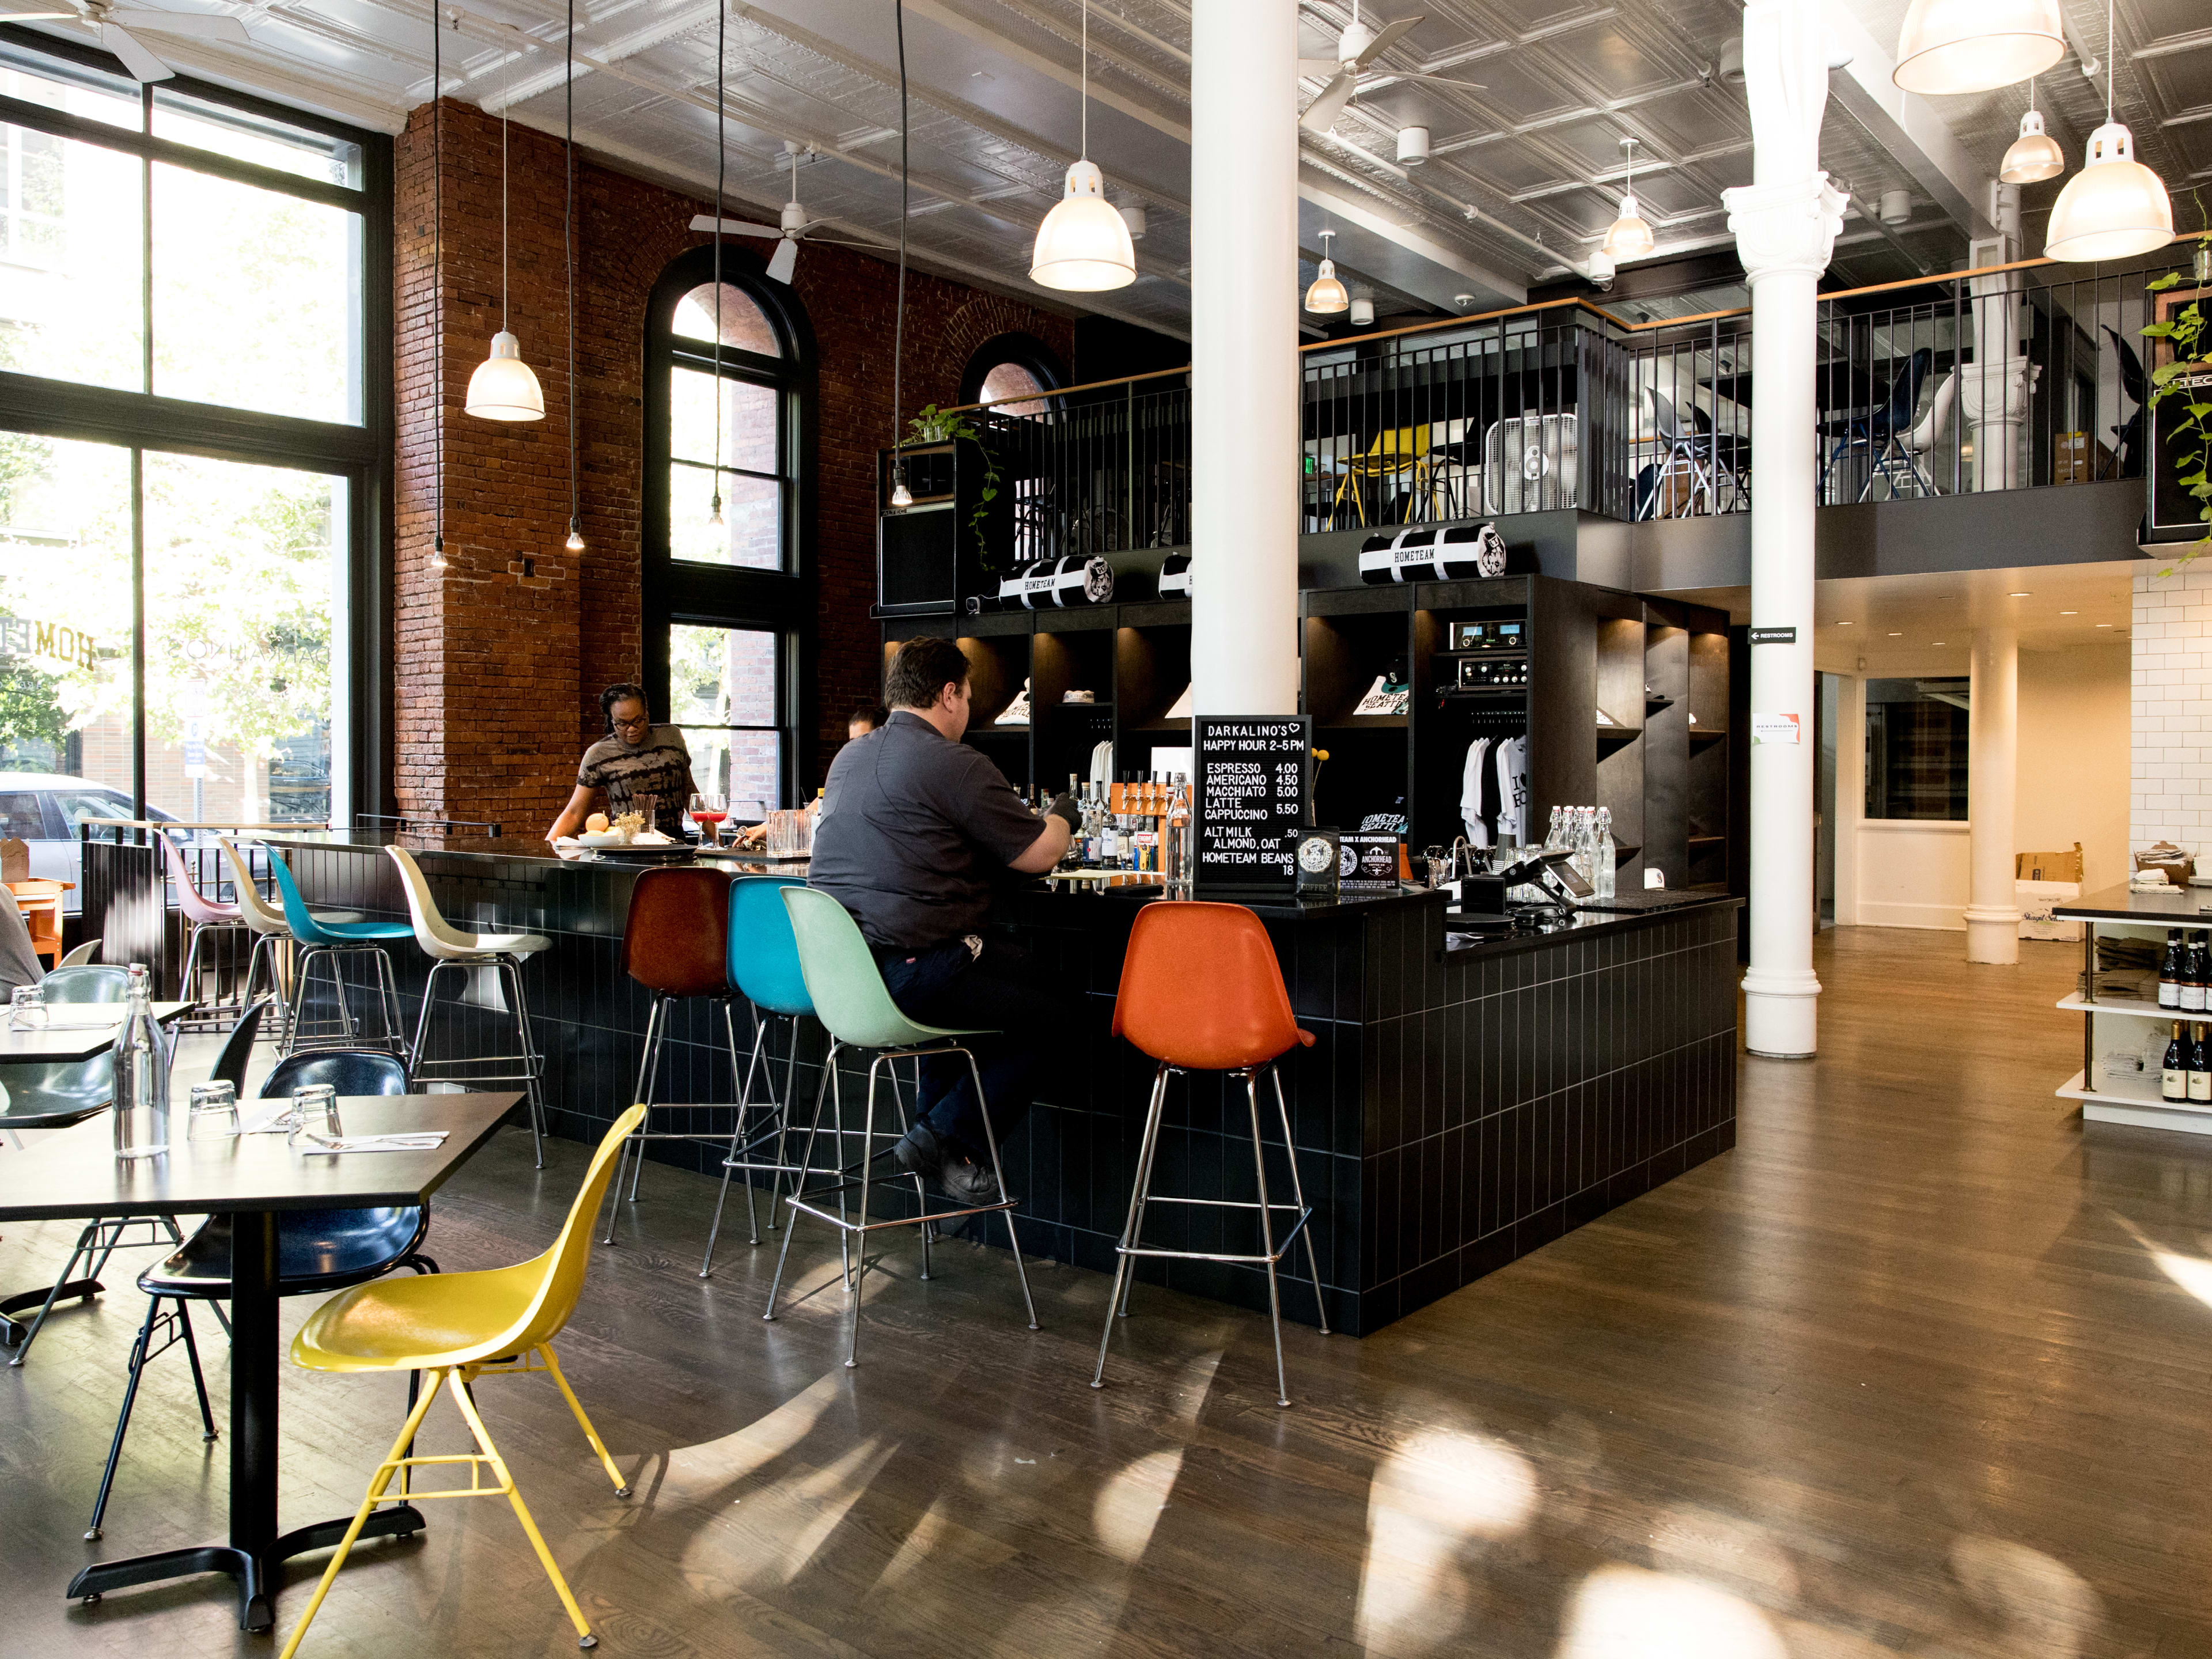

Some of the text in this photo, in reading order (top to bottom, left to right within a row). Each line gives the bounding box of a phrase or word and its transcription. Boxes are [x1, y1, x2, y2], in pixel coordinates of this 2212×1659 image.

[1395, 548, 1435, 563] HOMETEAM
[1025, 578, 1056, 590] HOMETEAM
[1209, 725, 1287, 736] DARKALINO'S
[1204, 740, 1236, 750] HAPPY
[1239, 740, 1266, 750] HOUR
[1290, 740, 1304, 750] PM
[1207, 763, 1298, 774] ESPRESSO 4.00
[1207, 775, 1297, 785] AMERICANO 4.50
[1207, 786, 1298, 797] MACCHIATO 5.00
[1206, 798, 1241, 808] LATTE
[1277, 804, 1298, 814] 5.50
[1205, 809, 1267, 820] CAPPUCCINO
[1205, 827, 1224, 837] ALT
[1226, 827, 1252, 837] MILK
[1203, 853, 1294, 863] HOMETEAM BEANS
[1283, 865, 1293, 875] 18
[1301, 883, 1327, 891] COFFEE
